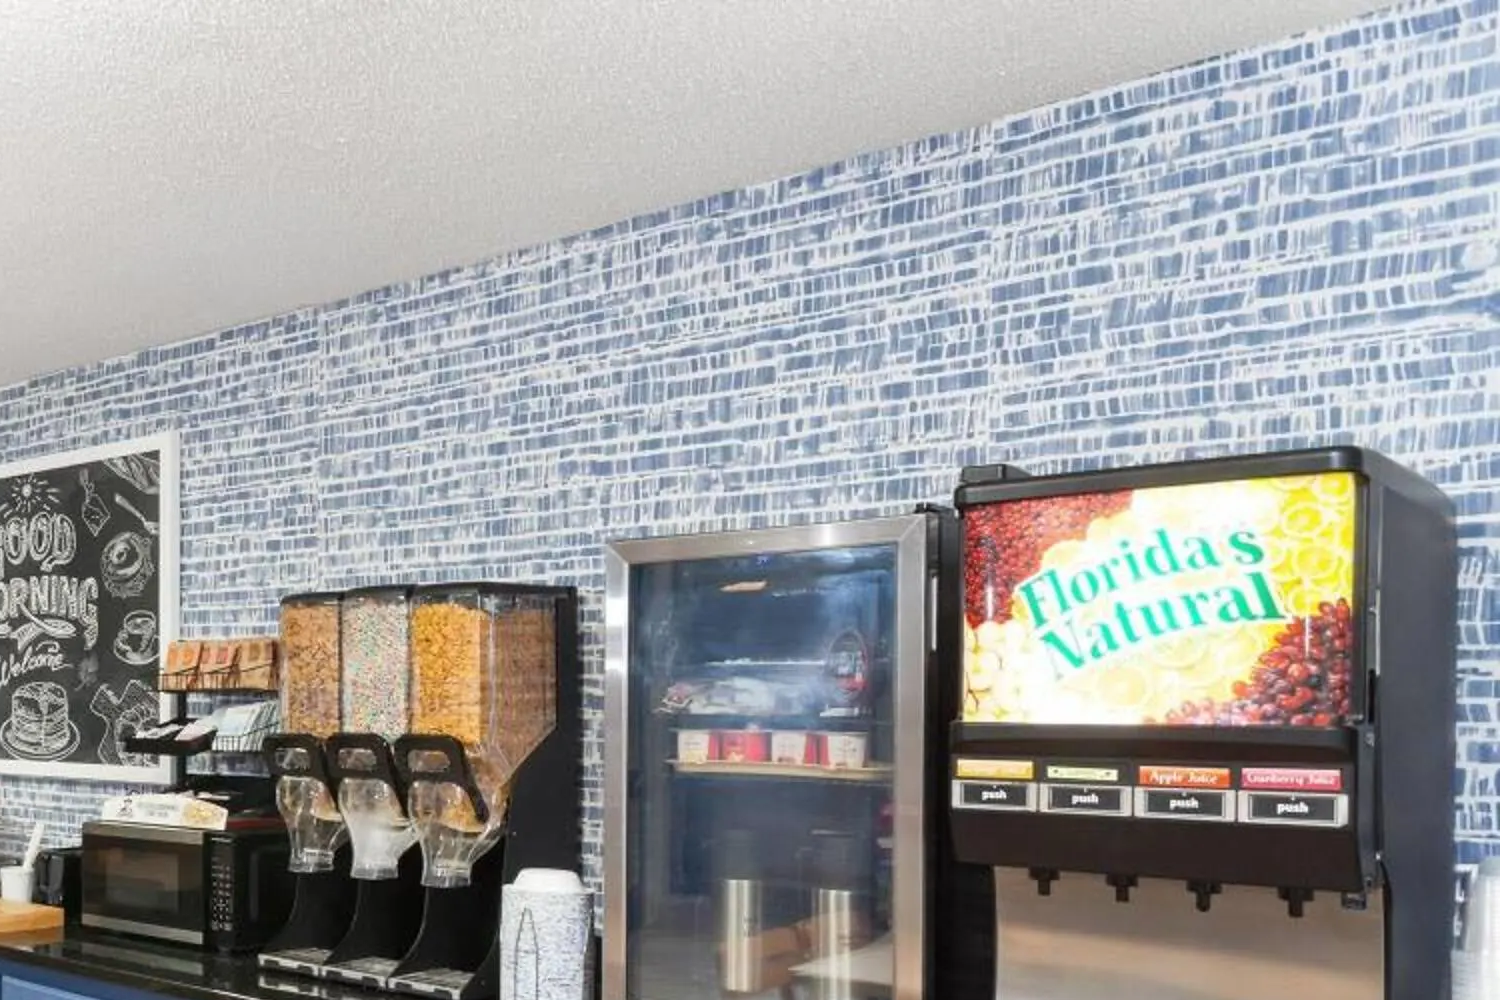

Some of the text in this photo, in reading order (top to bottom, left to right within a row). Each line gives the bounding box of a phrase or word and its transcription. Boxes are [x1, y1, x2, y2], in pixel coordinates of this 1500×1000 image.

[1038, 571, 1288, 681] Natural
[1149, 771, 1219, 785] Apple Juice
[981, 789, 1007, 801] push
[1071, 793, 1099, 805] push
[1169, 797, 1199, 810] push
[1276, 801, 1309, 815] push
